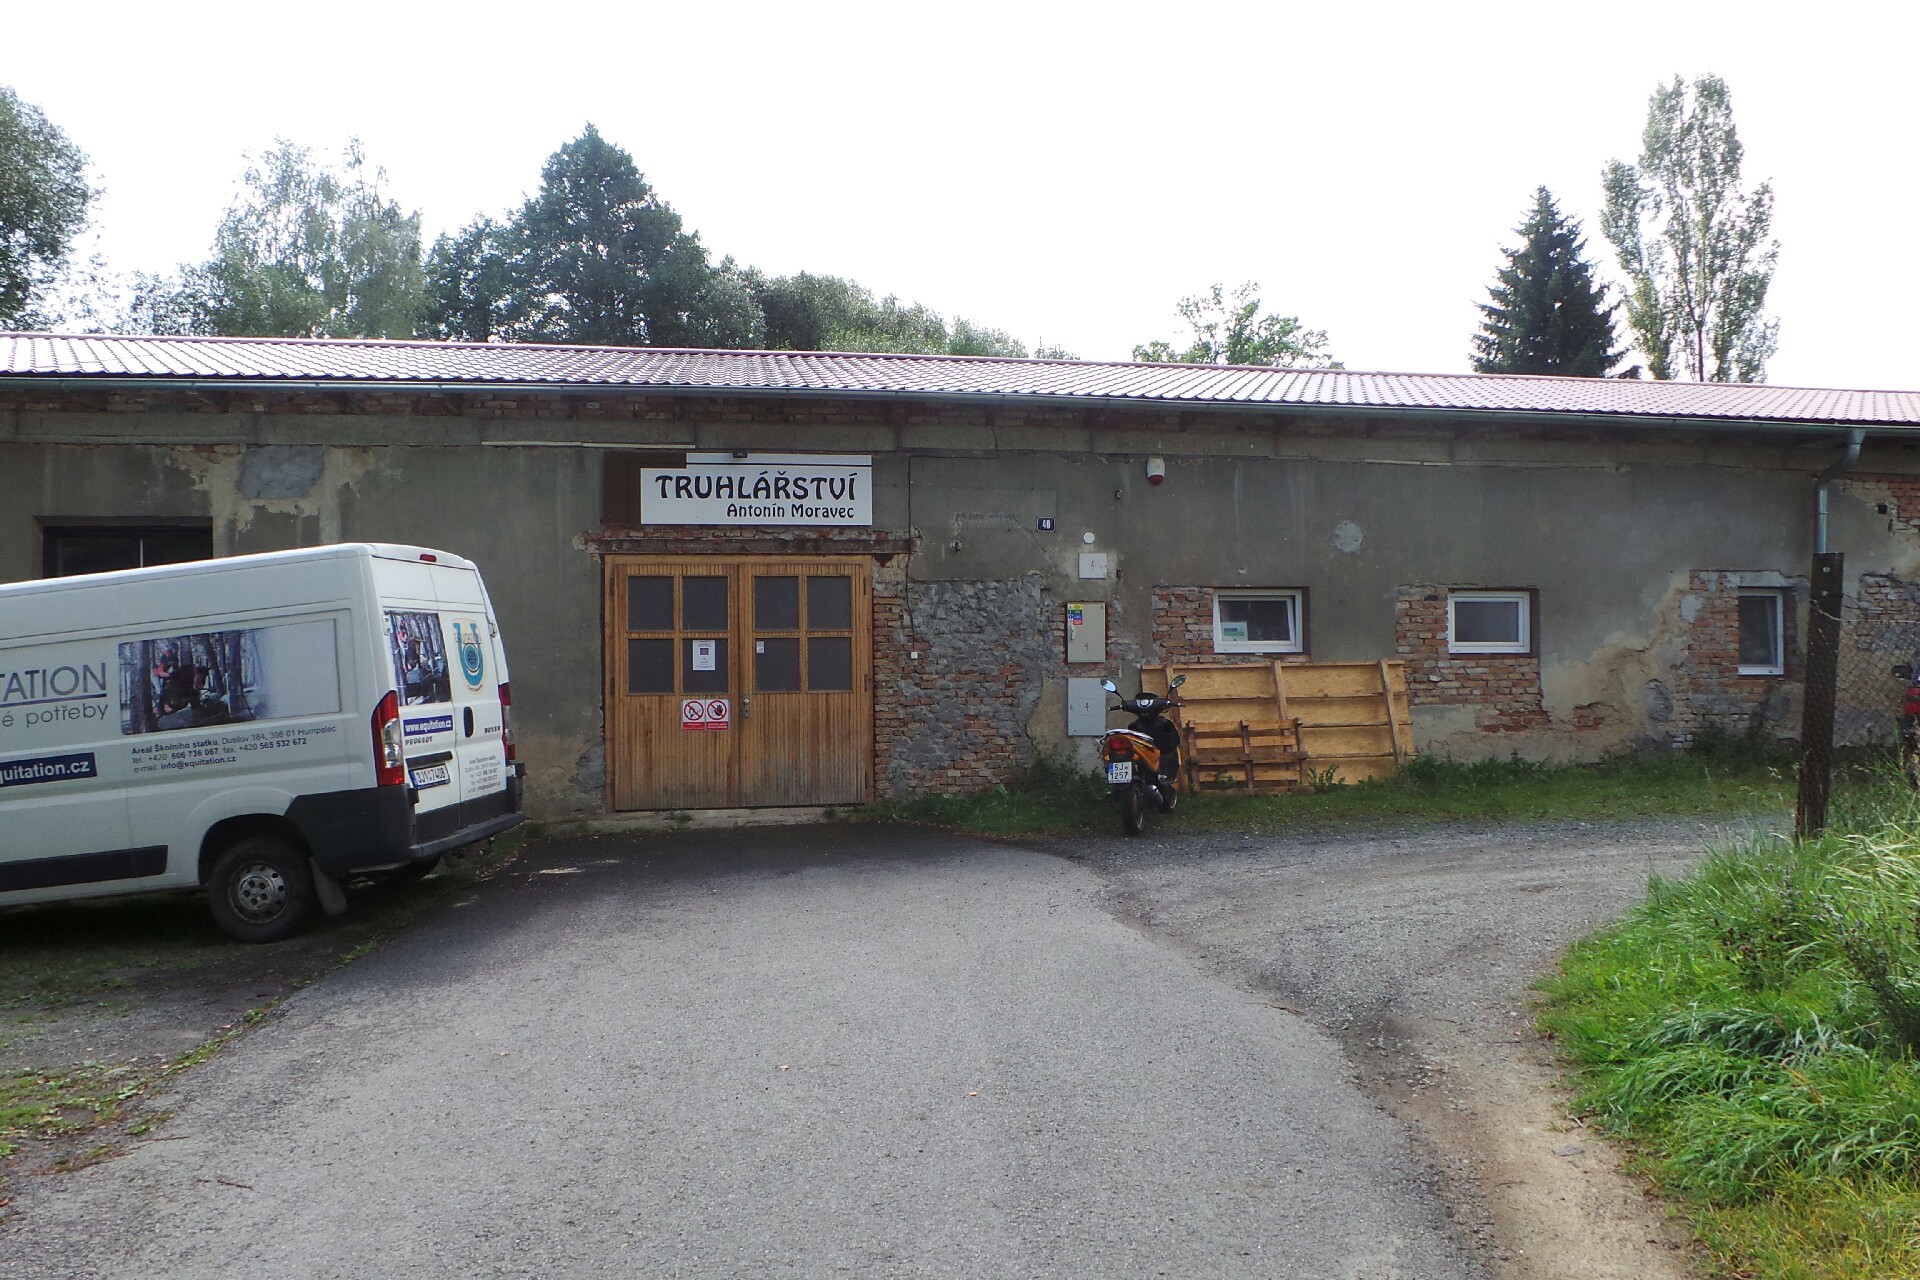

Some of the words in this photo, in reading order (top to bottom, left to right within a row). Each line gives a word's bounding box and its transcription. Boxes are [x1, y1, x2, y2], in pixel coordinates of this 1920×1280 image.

[655, 471, 858, 500] TRUHLÁŘSTVÍ
[726, 503, 785, 518] Antonín
[791, 504, 854, 518] Moravec
[1043, 519, 1051, 530] 40
[26, 703, 108, 728] potřeby
[285, 729, 295, 737] 01
[297, 725, 336, 736] Humpolec
[405, 720, 452, 732] www.equitation.cz
[188, 749, 203, 758] 736
[276, 739, 290, 747] 532
[292, 737, 307, 746] 672
[405, 736, 433, 746] PEUGEOT
[160, 756, 236, 770] info@equitation.cz
[1114, 763, 1124, 771] 5J
